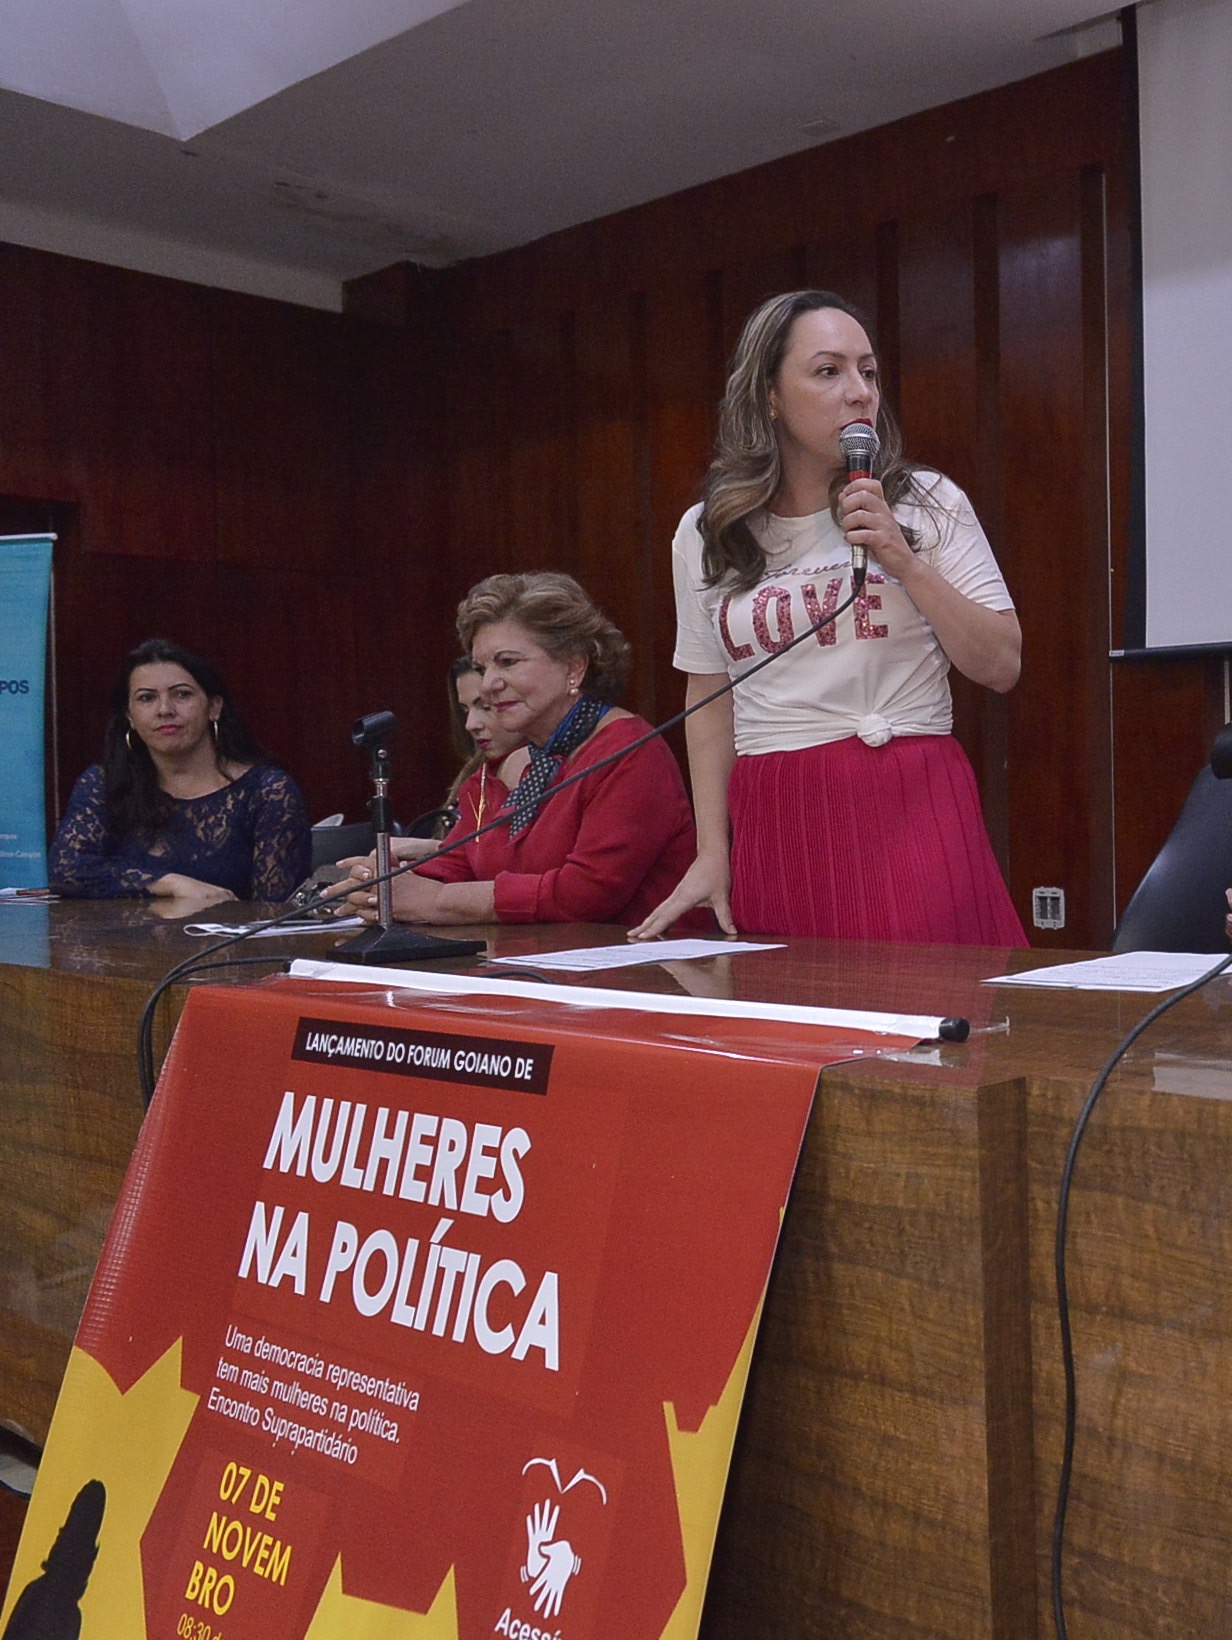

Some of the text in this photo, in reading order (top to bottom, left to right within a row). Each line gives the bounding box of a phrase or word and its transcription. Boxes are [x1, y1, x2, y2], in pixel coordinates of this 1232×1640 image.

[718, 571, 889, 662] LOVE
[305, 1032, 534, 1080] LANÇAMENTO DO FORUM GOIANO DE
[263, 1091, 532, 1223] MULHERES
[238, 1201, 559, 1371] NA POLÍTICA
[216, 1357, 400, 1443] tem mais mulheres na política.
[225, 1325, 420, 1412] Uma democracia representativa
[207, 1388, 358, 1465] Encontro Suprapartidário
[220, 1462, 285, 1522] 07 DE
[185, 1560, 235, 1615] BRO
[203, 1512, 292, 1586] NOVEM
